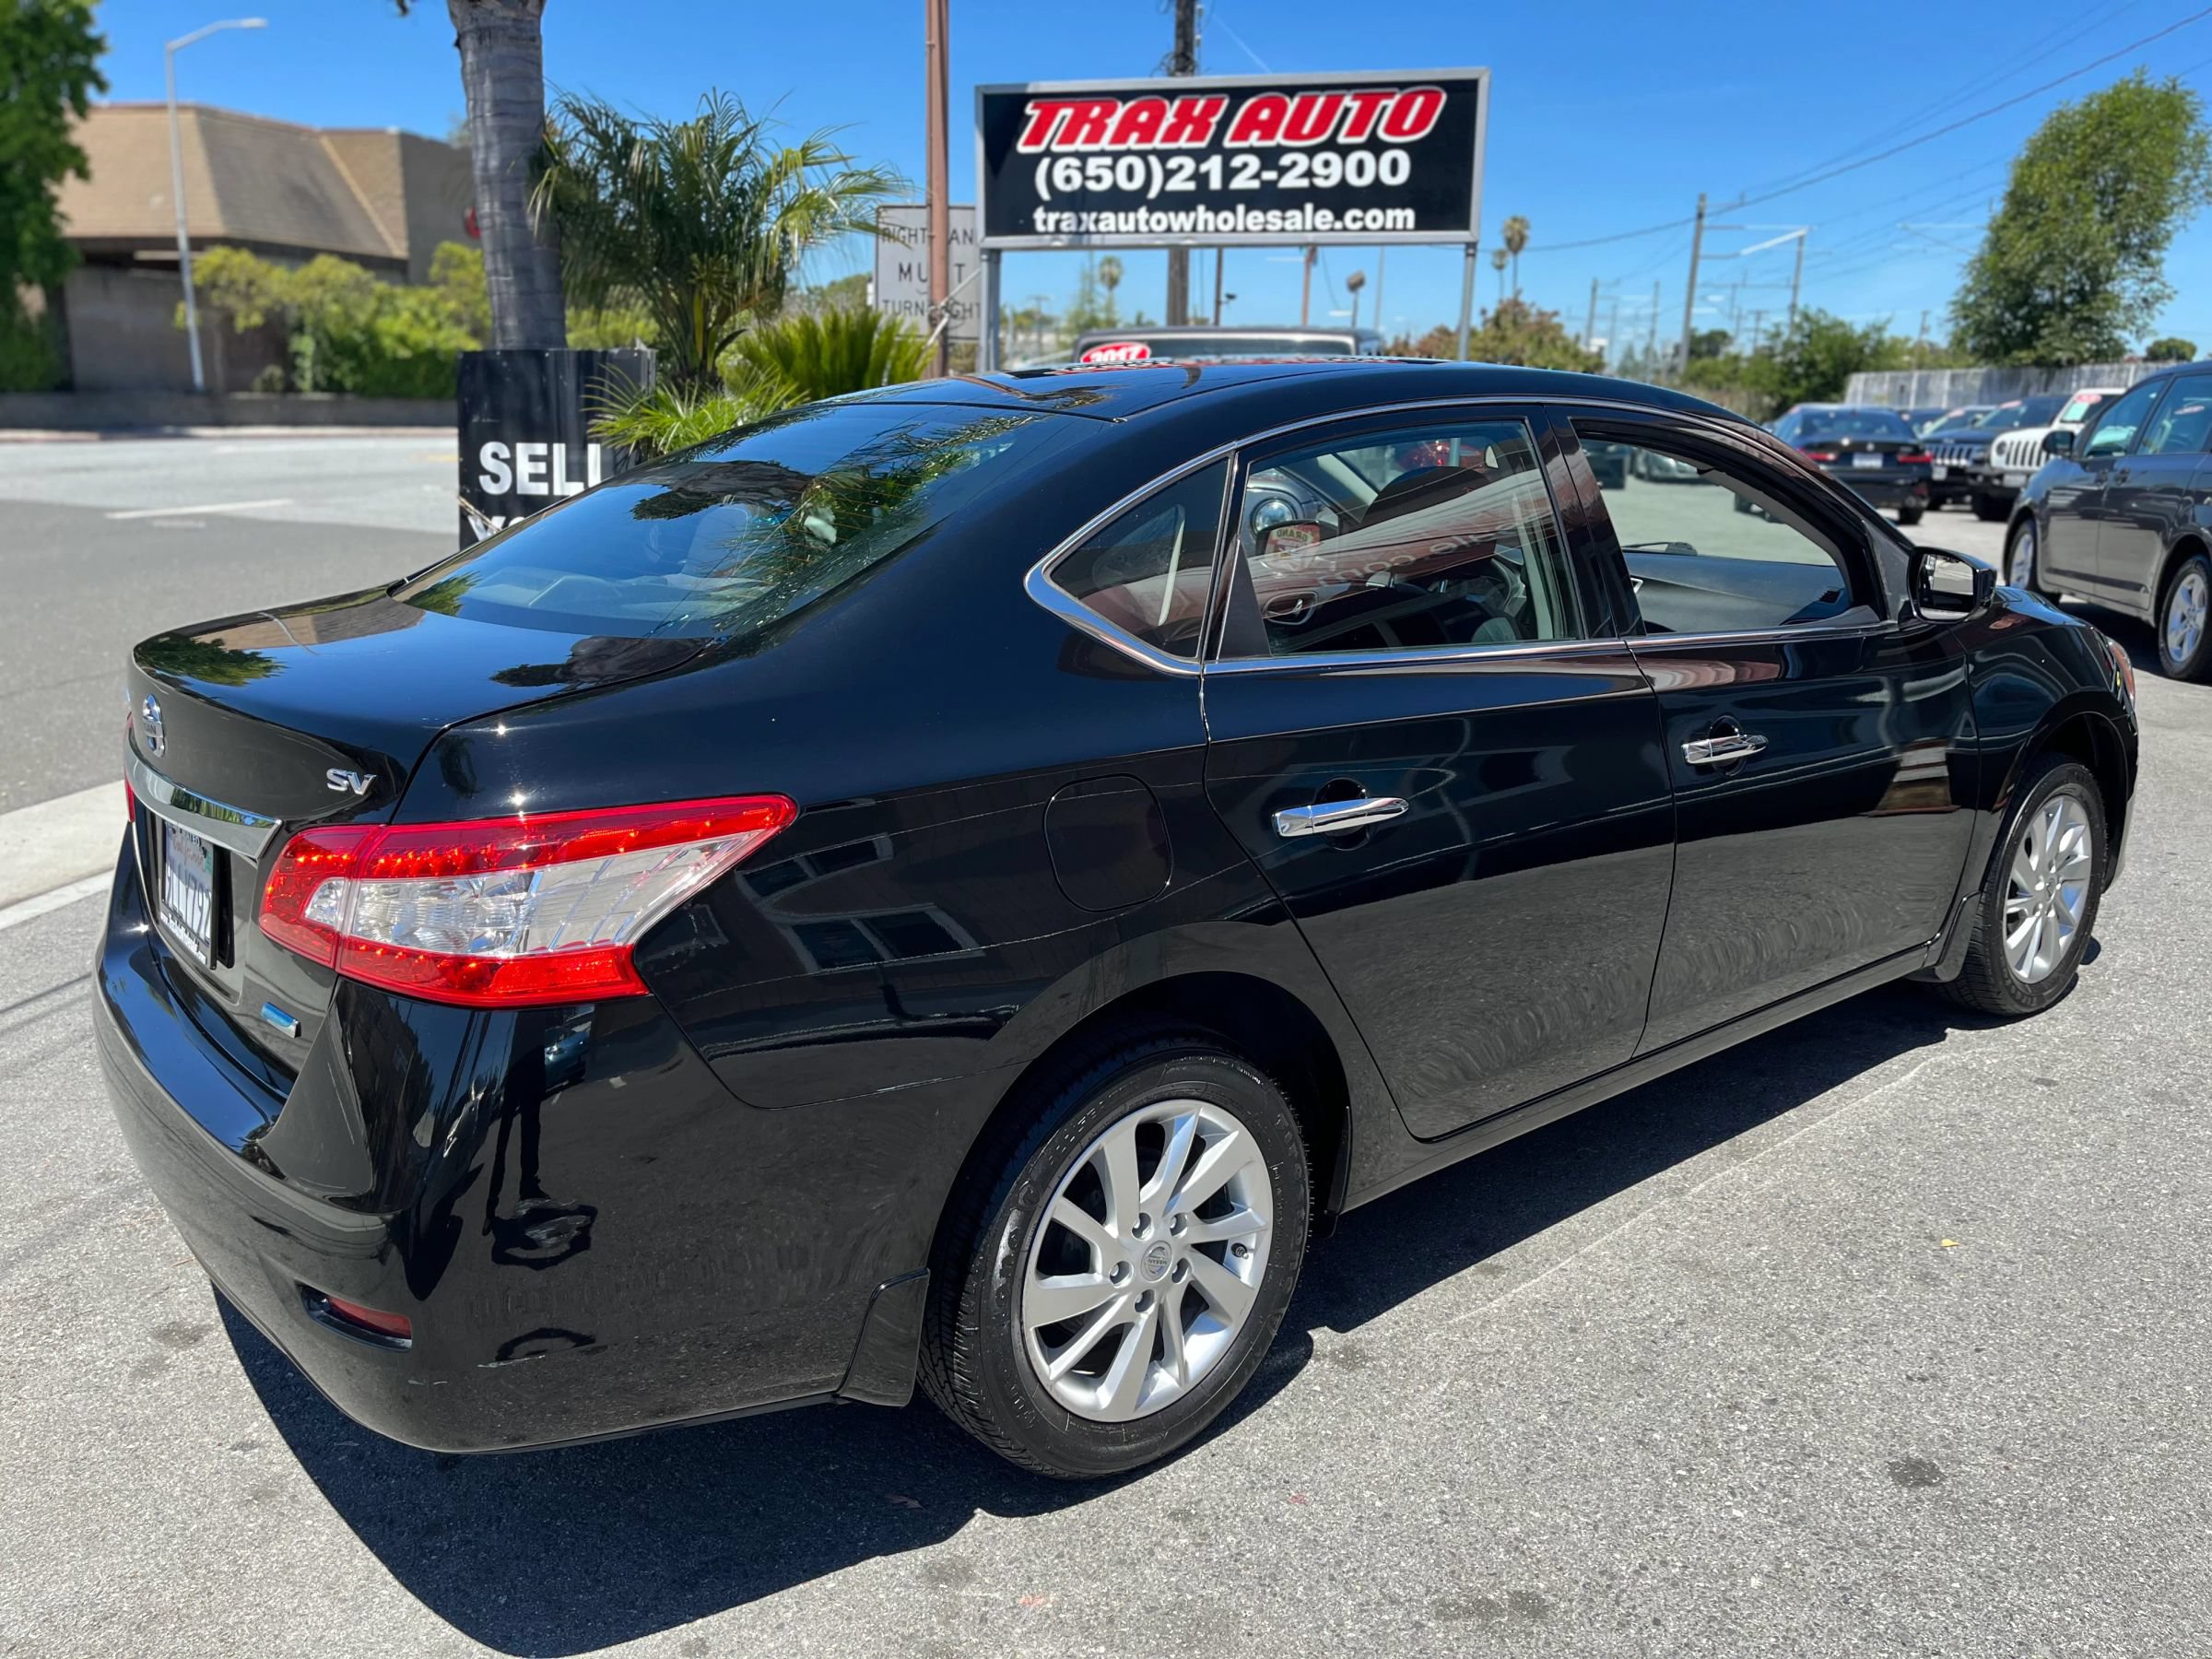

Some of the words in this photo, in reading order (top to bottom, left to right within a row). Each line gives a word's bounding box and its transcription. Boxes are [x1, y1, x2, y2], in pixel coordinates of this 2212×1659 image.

[1017, 95, 1229, 153] TRAX
[1223, 87, 1447, 149] AUTO
[1033, 149, 1412, 200] (650)212-2900
[1032, 203, 1416, 234] traxautowholesale.com
[899, 262, 966, 283] MUT
[882, 300, 924, 317] TURN
[326, 768, 377, 794] SV
